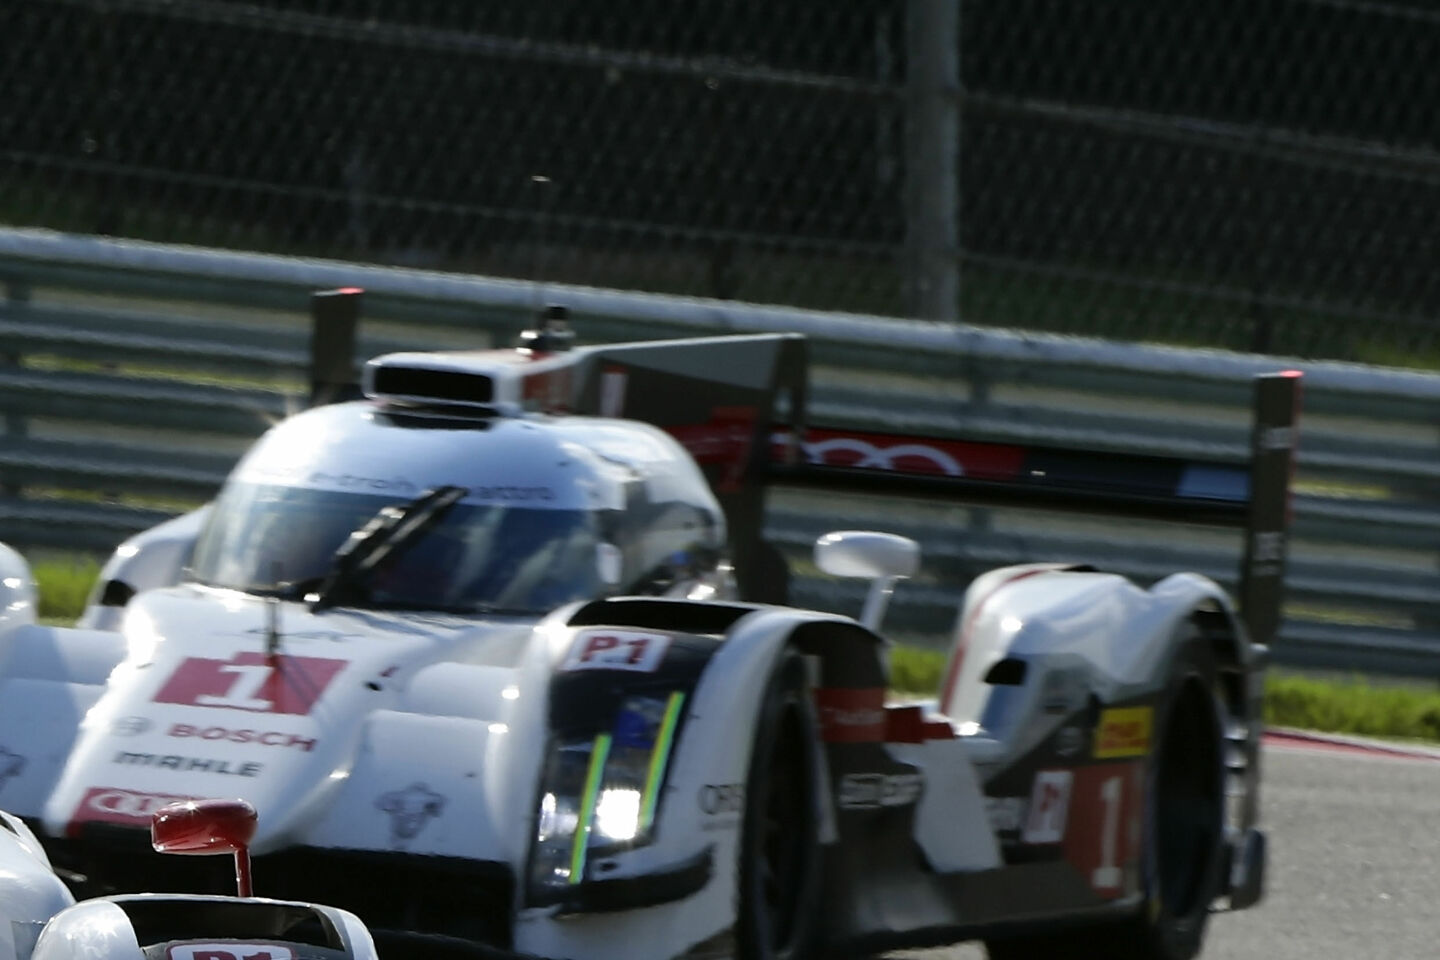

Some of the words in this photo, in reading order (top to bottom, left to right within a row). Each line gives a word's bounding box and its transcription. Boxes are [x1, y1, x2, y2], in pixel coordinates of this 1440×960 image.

[580, 635, 653, 665] P1
[196, 664, 276, 711] 1
[168, 723, 317, 752] BOSCH
[112, 752, 265, 778] MAHLE
[1092, 775, 1123, 888] 1
